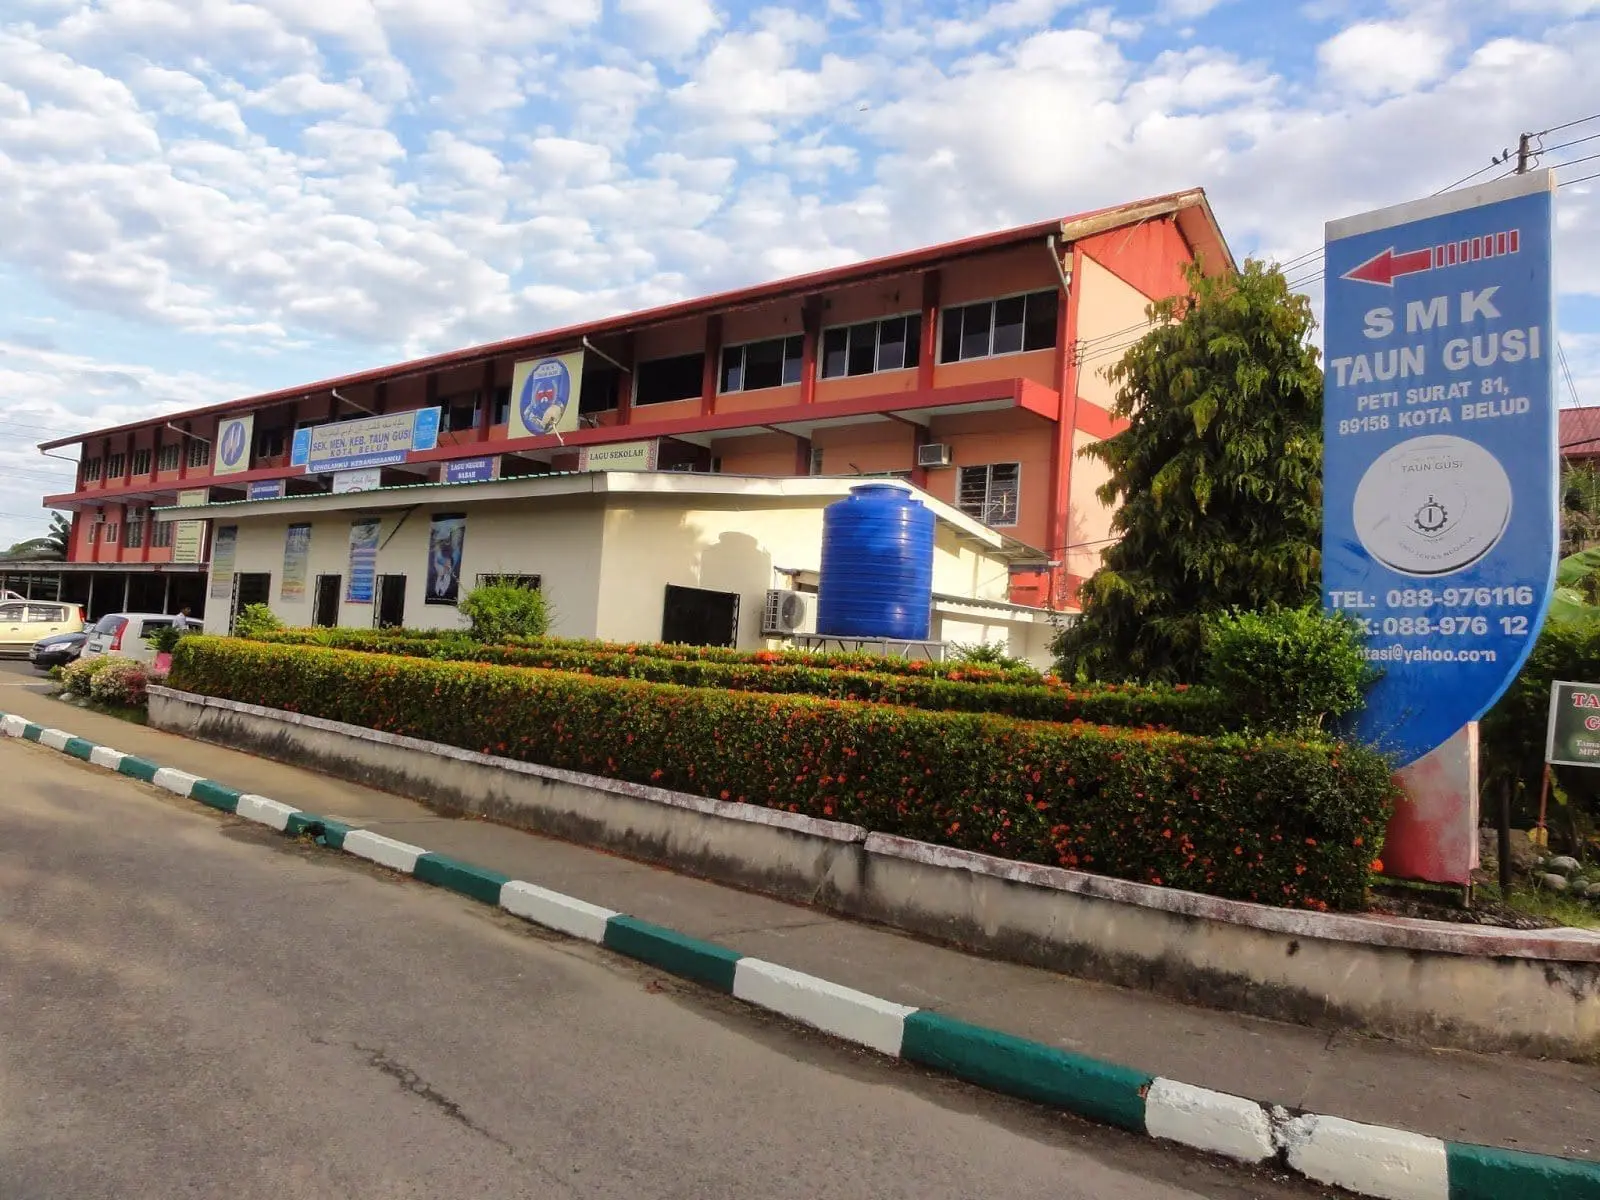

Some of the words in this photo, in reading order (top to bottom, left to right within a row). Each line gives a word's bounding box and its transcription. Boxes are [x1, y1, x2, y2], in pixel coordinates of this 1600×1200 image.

[1331, 345, 1425, 387] TAUN
[1442, 326, 1540, 371] GUSI
[1357, 392, 1399, 412] PETI
[1406, 381, 1472, 405] SURAT
[1481, 376, 1509, 396] 81,
[1339, 415, 1389, 435] 89158
[1398, 407, 1452, 428] KOTA
[1461, 397, 1530, 421] BELUD
[370, 431, 389, 443] TAUN
[392, 428, 411, 440] GUSI
[590, 452, 608, 461] LAGU
[610, 449, 644, 459] SEKOLAH
[1402, 463, 1431, 473] TAUN
[1434, 460, 1463, 470] GUSI
[1329, 591, 1376, 608] TEL:
[1386, 586, 1532, 607] 088-976116
[1355, 618, 1379, 635] X:
[1383, 616, 1488, 636] 088-976
[1500, 616, 1528, 635] 12
[1358, 643, 1497, 664] tasi@yahoo.com
